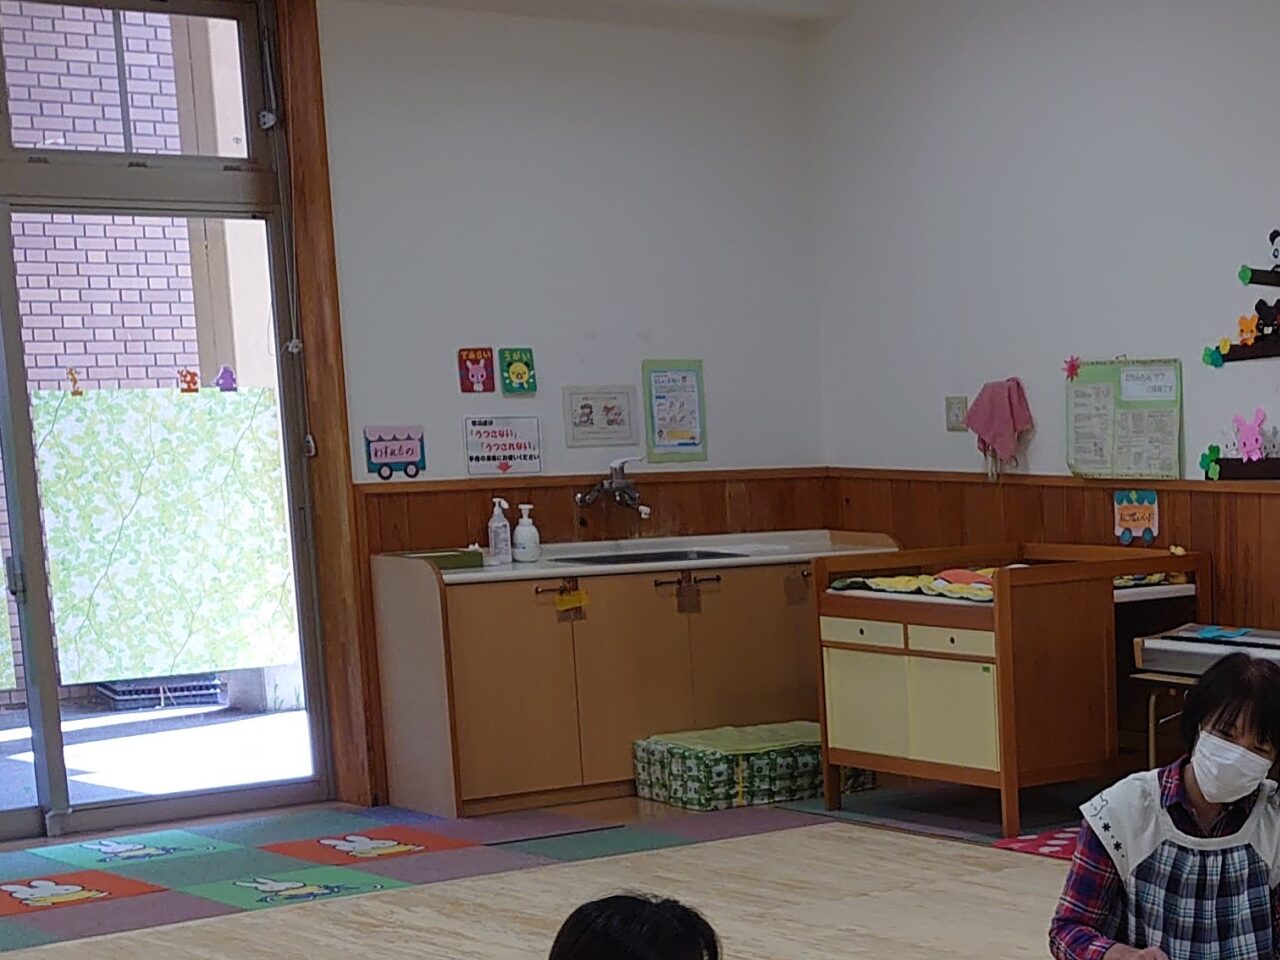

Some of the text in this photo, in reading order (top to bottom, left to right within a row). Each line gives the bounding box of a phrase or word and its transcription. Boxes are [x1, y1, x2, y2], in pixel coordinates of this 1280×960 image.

[460, 350, 492, 360] てあらい
[503, 351, 531, 361] うがい
